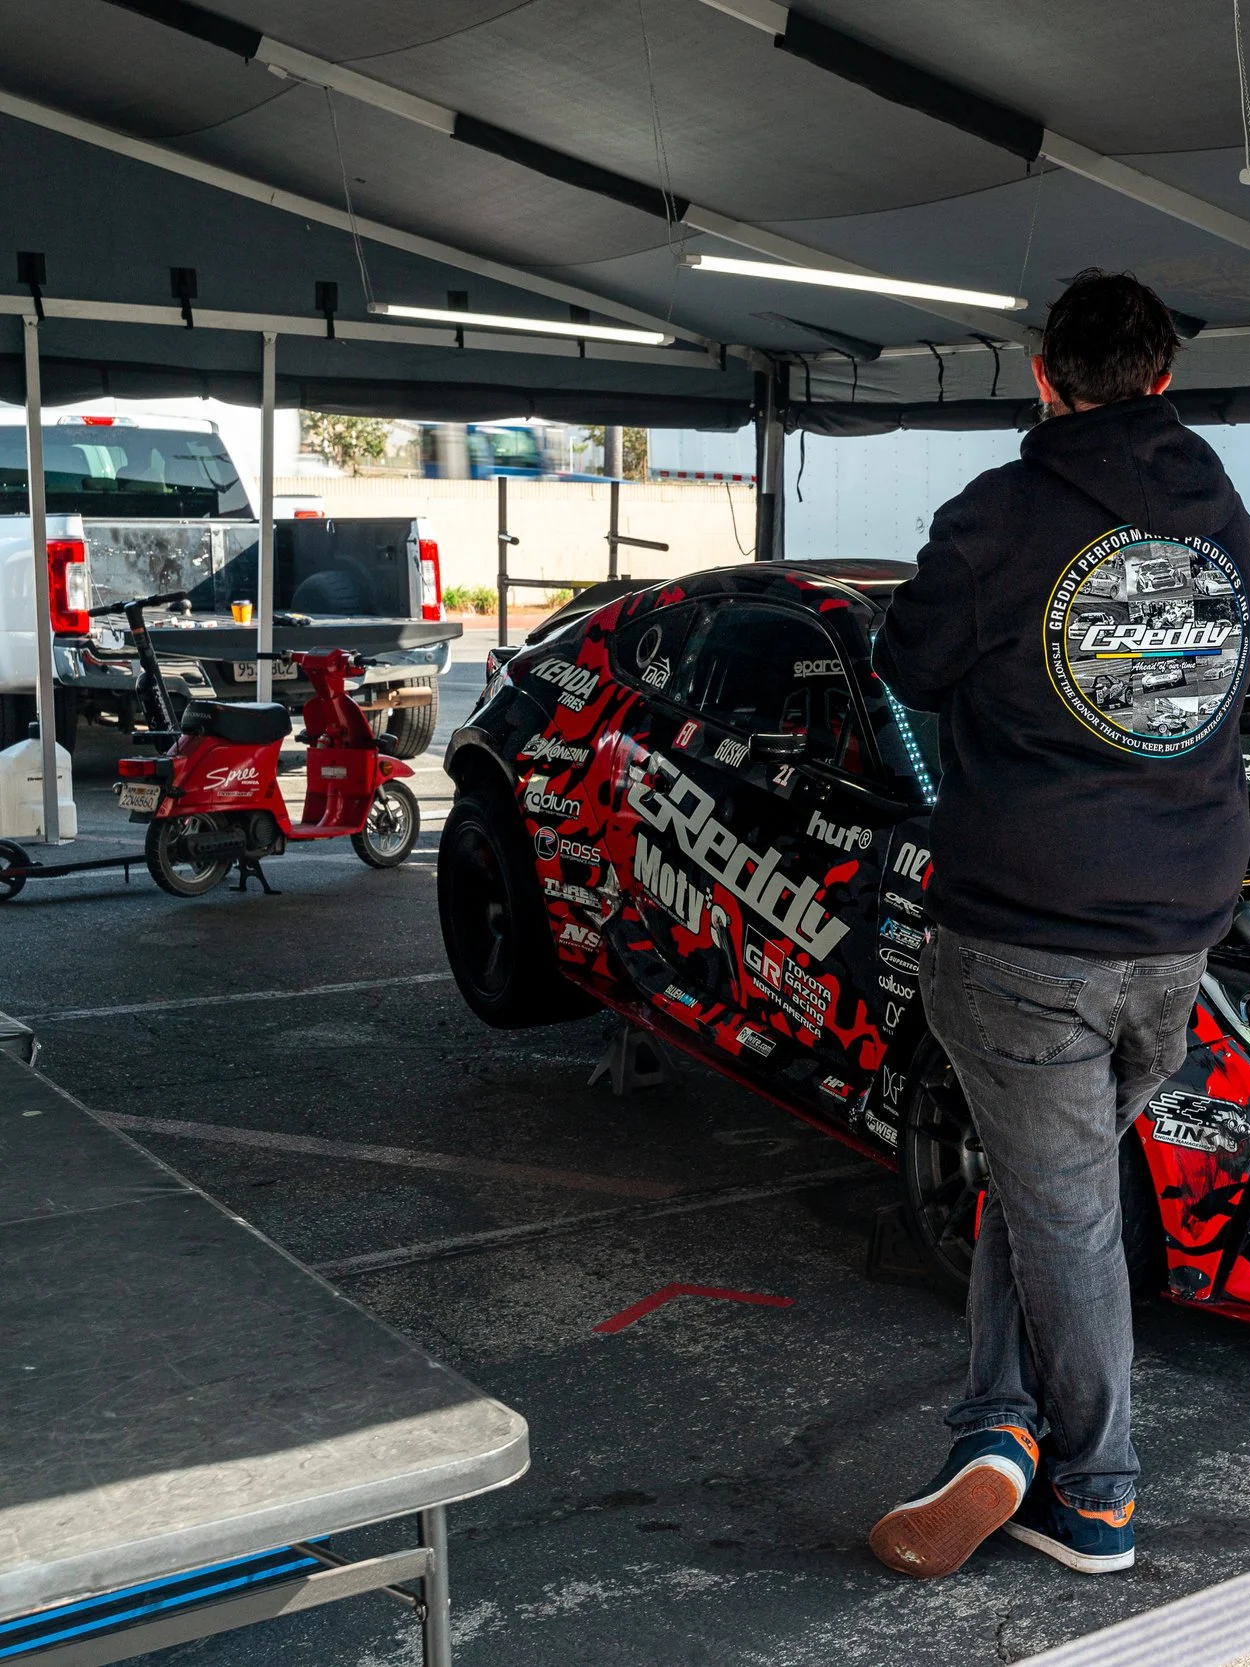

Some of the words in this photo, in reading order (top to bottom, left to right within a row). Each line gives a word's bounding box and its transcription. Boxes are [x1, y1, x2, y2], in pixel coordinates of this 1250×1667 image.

[1049, 570, 1081, 630] GREDDY
[1080, 621, 1230, 652] GReddy
[529, 657, 600, 700] KENDA
[1181, 661, 1197, 669] time
[557, 691, 586, 713] TIRES
[1054, 660, 1066, 679] NOT
[1061, 678, 1075, 698] THE
[1071, 697, 1100, 727] HONOR
[1100, 722, 1122, 741] THAT
[1121, 735, 1141, 748] YOU
[1165, 742, 1180, 753] BUT
[1180, 735, 1194, 748] THE
[1222, 695, 1233, 713] YOU
[714, 738, 750, 768] GUSHI
[203, 766, 259, 790] Spree
[772, 764, 796, 788] 21
[525, 788, 581, 816] radium
[560, 839, 601, 863] ROSS
[745, 944, 781, 988] GR
[786, 956, 832, 1002] TOYOTA
[784, 971, 827, 1012] GAZOO
[753, 976, 782, 1007] NORTH
[782, 1002, 822, 1039] AMERICA
[822, 1074, 855, 1098] HPS
[1154, 1134, 1175, 1144] ENGINE
[1176, 1138, 1216, 1152] MANAGEMENT
[1156, 1120, 1220, 1146] LINK
